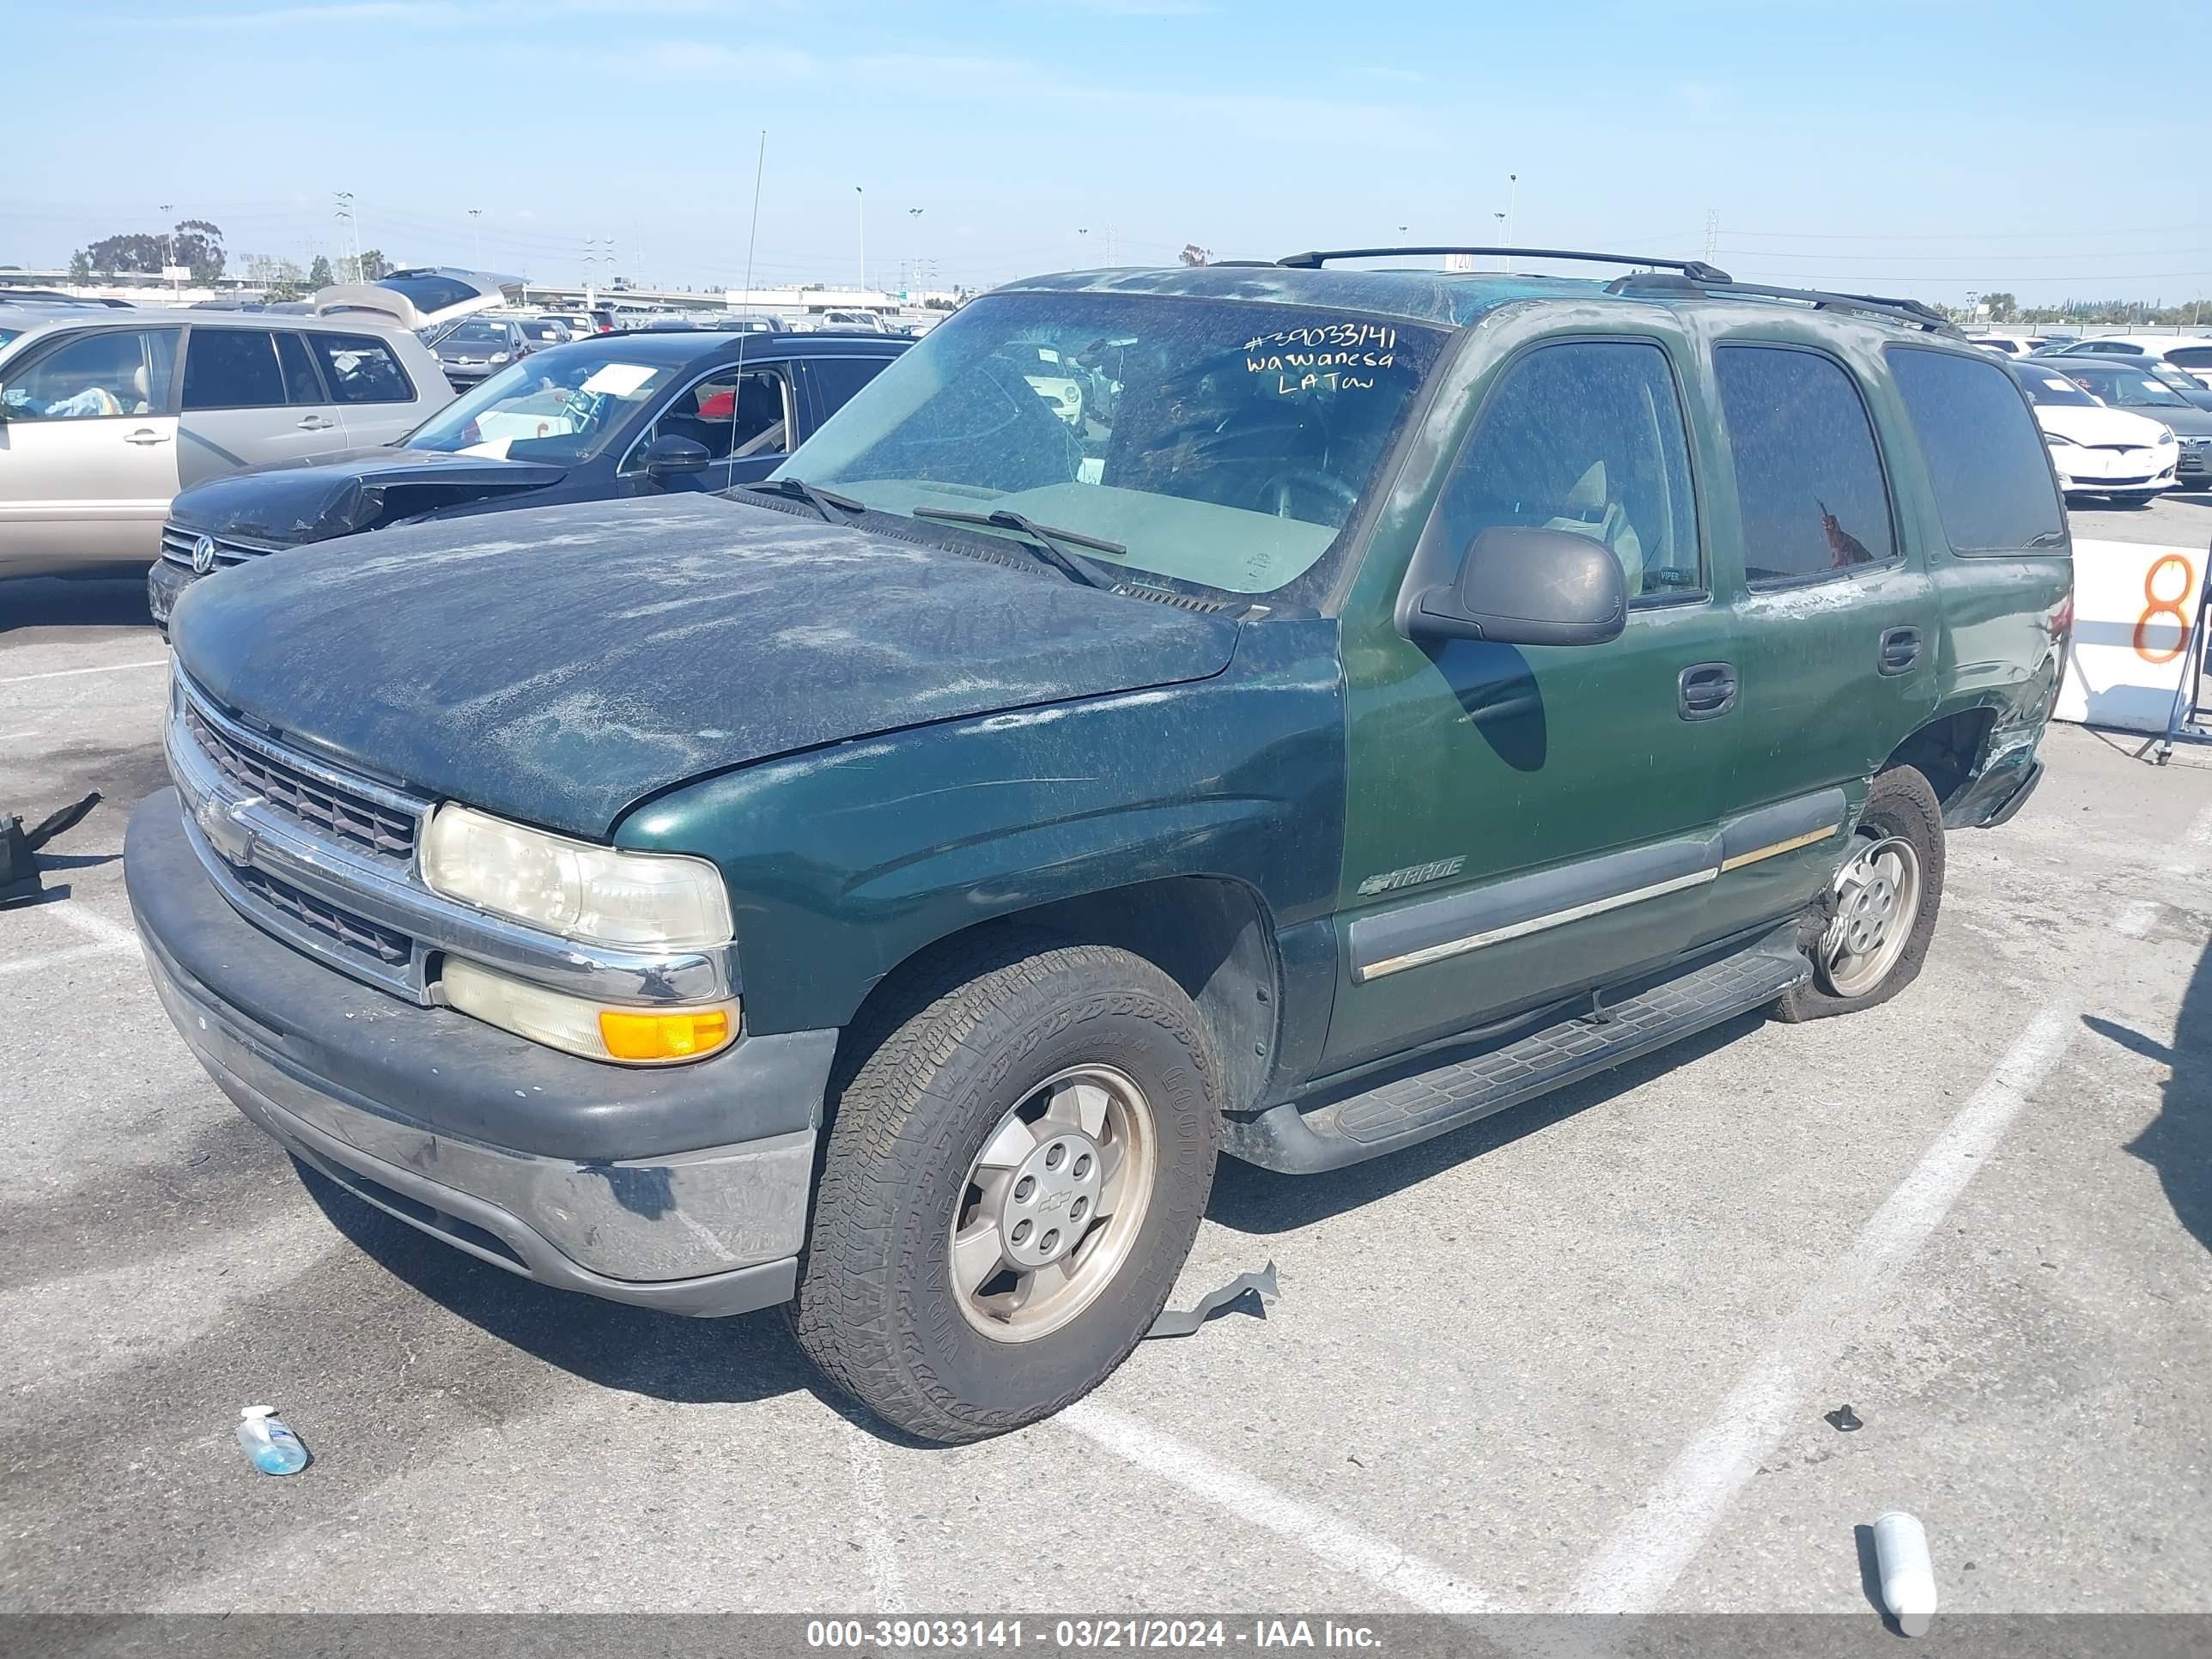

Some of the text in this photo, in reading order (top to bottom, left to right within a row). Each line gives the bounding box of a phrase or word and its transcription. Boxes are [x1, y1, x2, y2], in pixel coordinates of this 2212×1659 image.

[1243, 324, 1396, 352] #39033141
[1661, 571, 1680, 581] VIPER
[2133, 554, 2194, 664] 8
[1389, 855, 1468, 890] TAHOE
[1119, 1066, 1200, 1318] GOODYEAR
